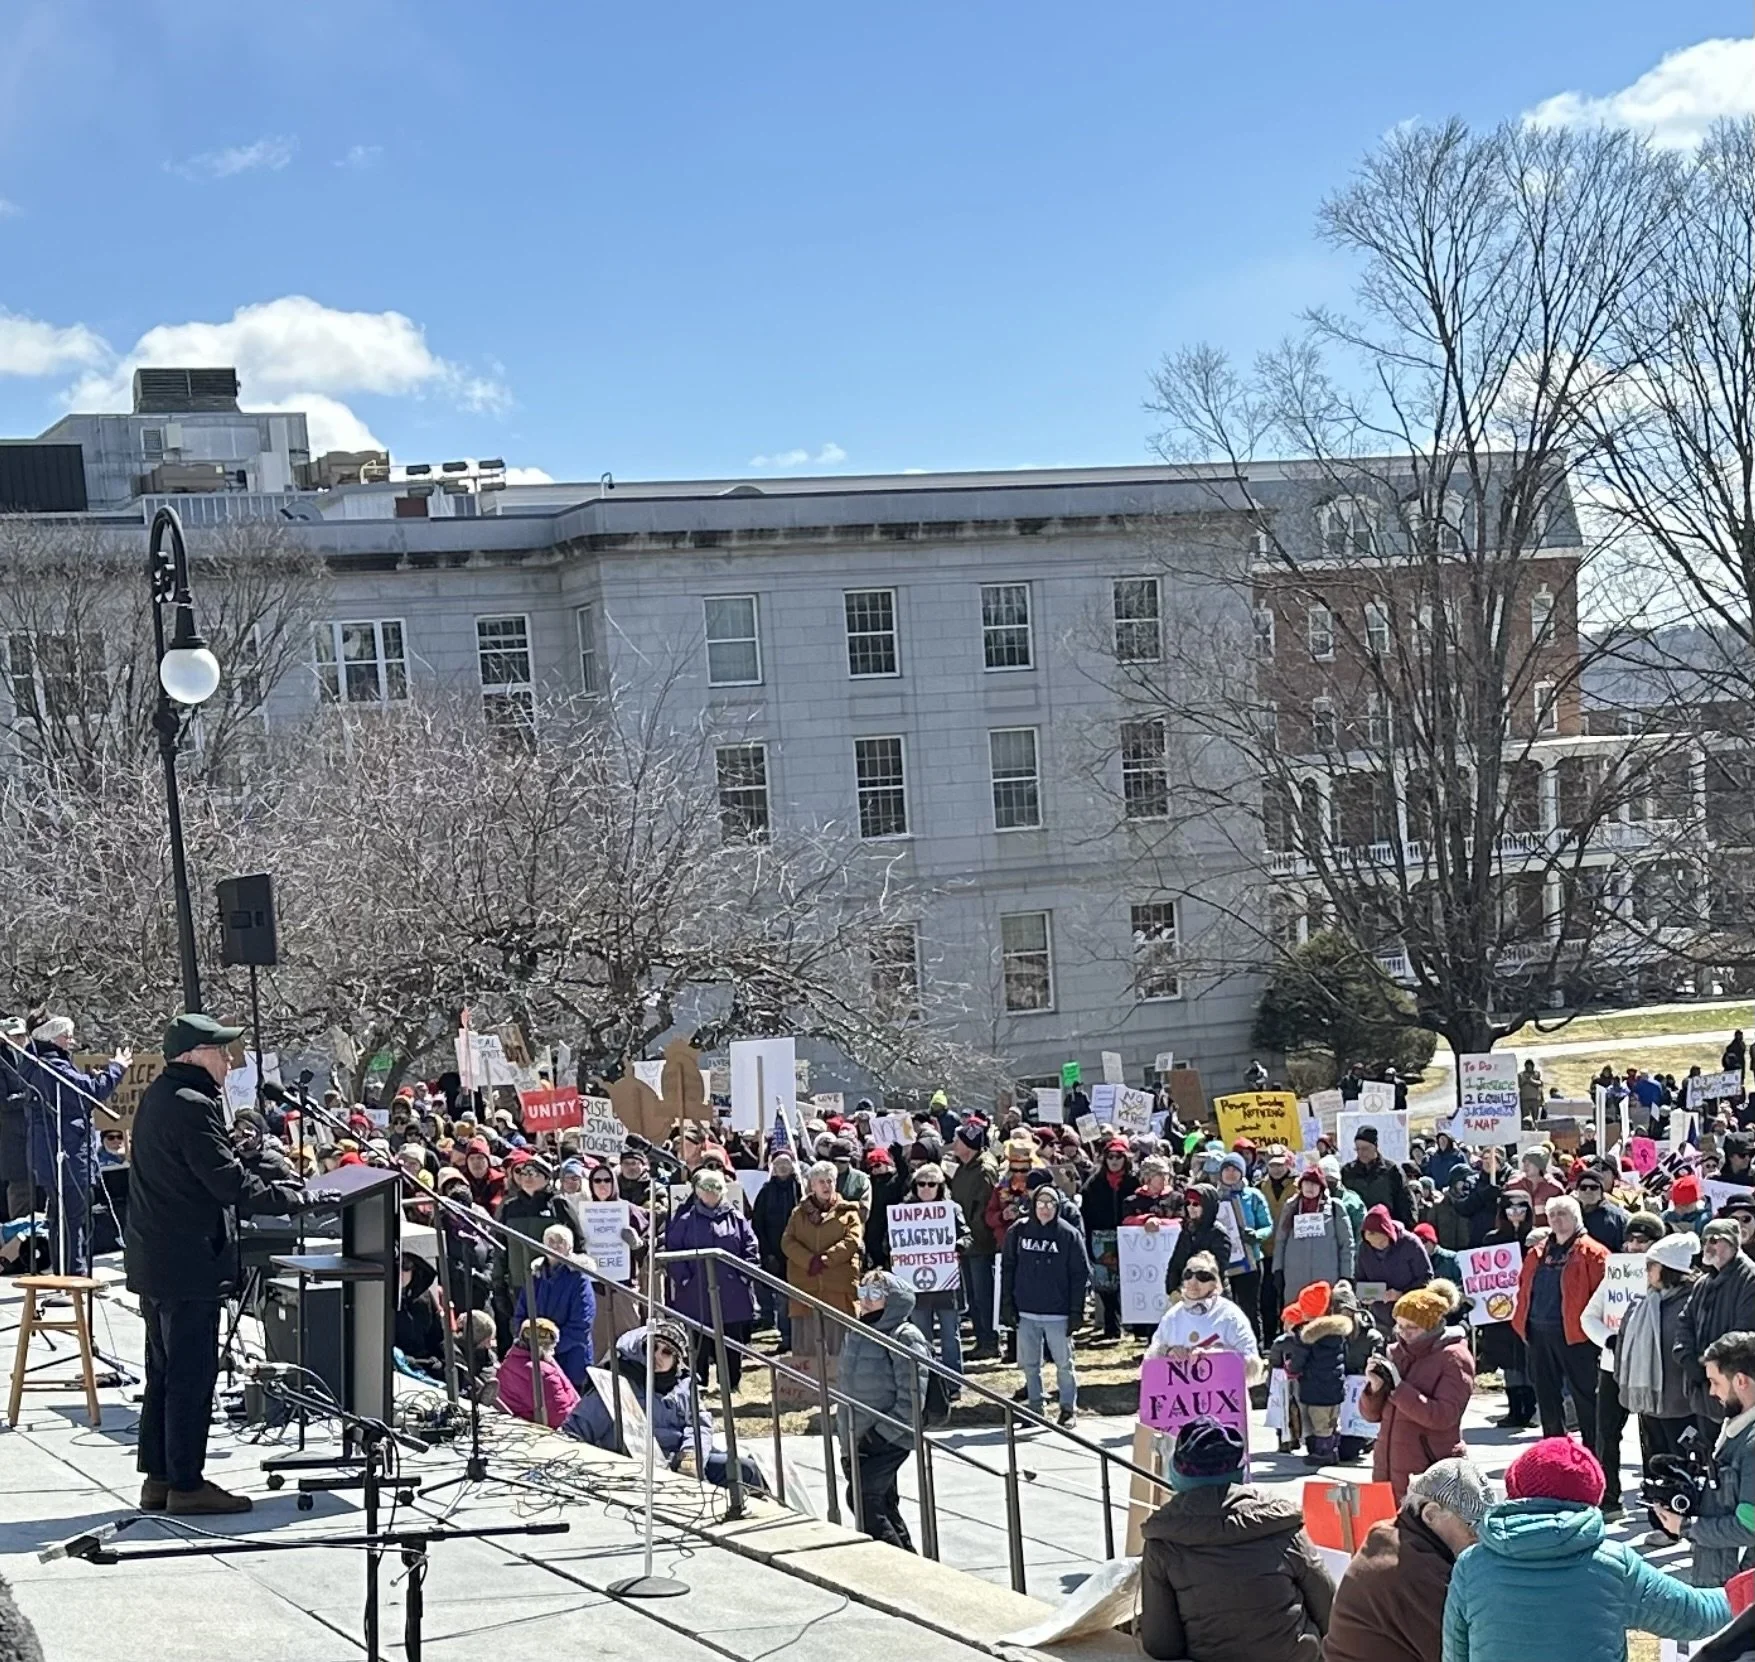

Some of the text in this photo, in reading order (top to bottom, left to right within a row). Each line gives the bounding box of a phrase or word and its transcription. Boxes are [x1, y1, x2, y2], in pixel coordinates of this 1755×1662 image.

[1463, 1061, 1475, 1072] To
[1123, 1091, 1145, 1103] NO
[527, 1099, 576, 1119] UNITY
[579, 1098, 609, 1118] RISE
[587, 1119, 624, 1135] STAND
[1474, 1119, 1500, 1132] NAP
[892, 1206, 946, 1222] UNPAID
[891, 1226, 954, 1248] PEACEFUL
[1470, 1249, 1512, 1274] NO
[1465, 1270, 1518, 1295] KINGS
[1166, 1357, 1213, 1386] NO
[1149, 1389, 1241, 1420] FAUX
